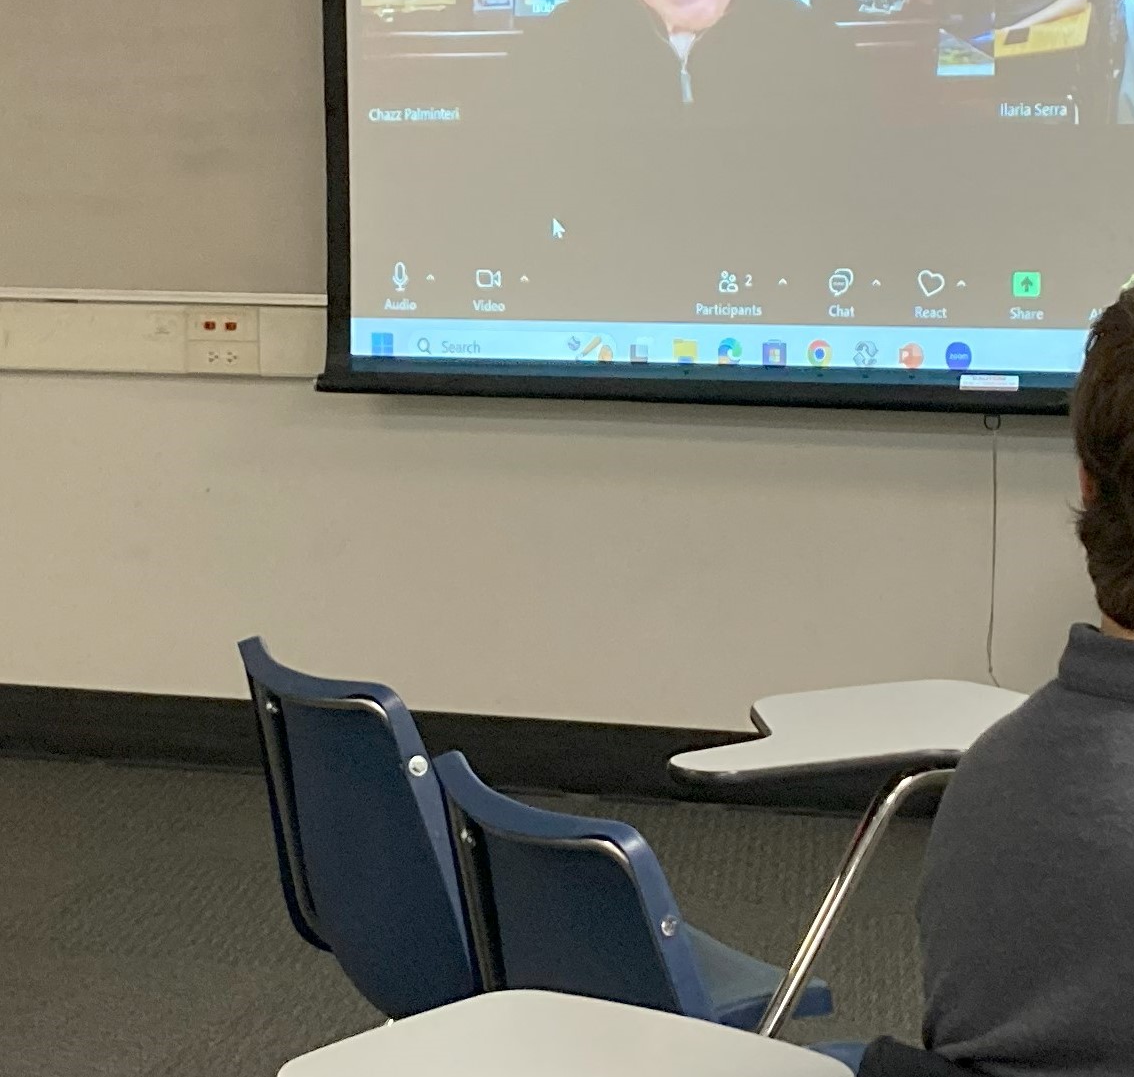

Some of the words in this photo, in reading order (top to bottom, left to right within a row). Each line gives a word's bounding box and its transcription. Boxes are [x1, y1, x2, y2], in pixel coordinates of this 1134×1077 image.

[368, 107, 402, 122] Chazz
[1000, 102, 1032, 117] Ilaria
[1034, 102, 1068, 117] Serra
[744, 274, 754, 288] 2
[383, 298, 418, 312] Audio
[472, 299, 506, 313] Video
[695, 302, 763, 319] Participants
[828, 304, 856, 318] Chat
[914, 305, 948, 320] React
[1009, 307, 1045, 321] Share
[440, 339, 482, 356] Search
